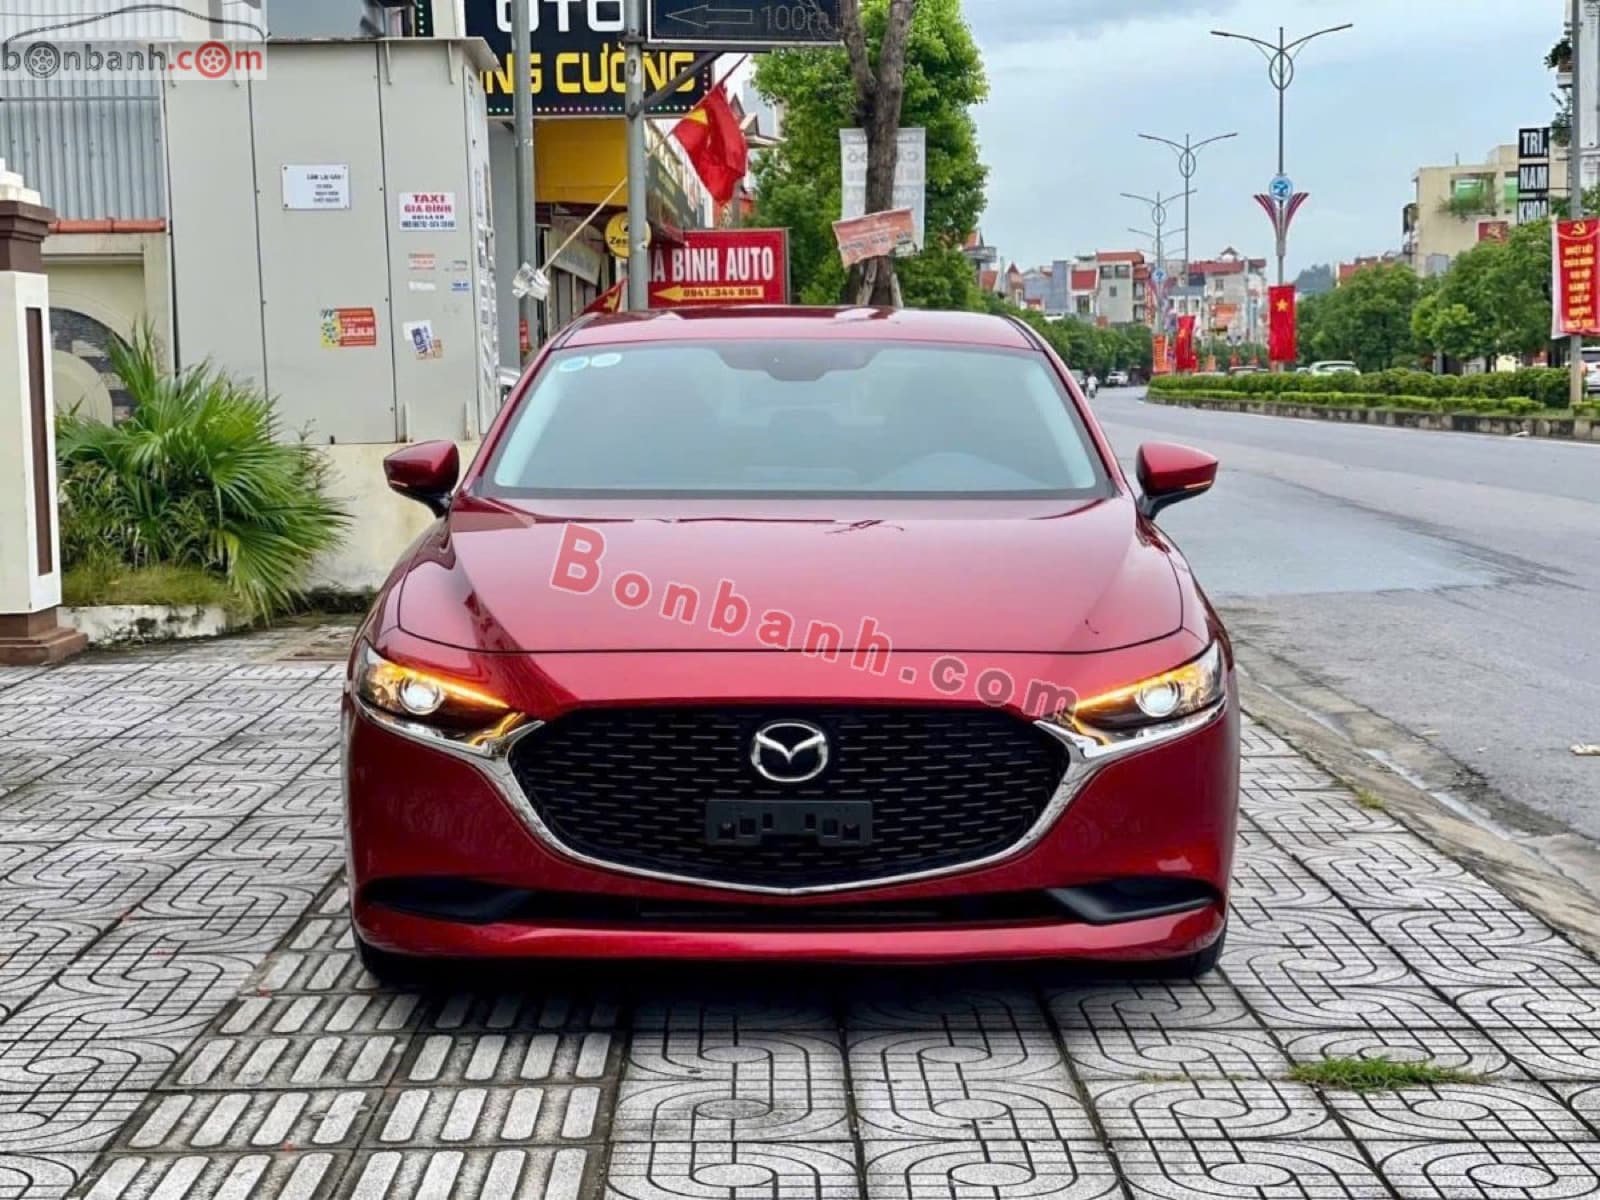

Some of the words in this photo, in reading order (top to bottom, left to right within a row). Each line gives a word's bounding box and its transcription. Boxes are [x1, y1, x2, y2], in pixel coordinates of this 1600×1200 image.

[1519, 166, 1548, 190] NAM
[412, 194, 445, 203] TAXI
[404, 204, 423, 213] GIA
[671, 242, 719, 282] BÌNH
[725, 246, 775, 282] AUTO
